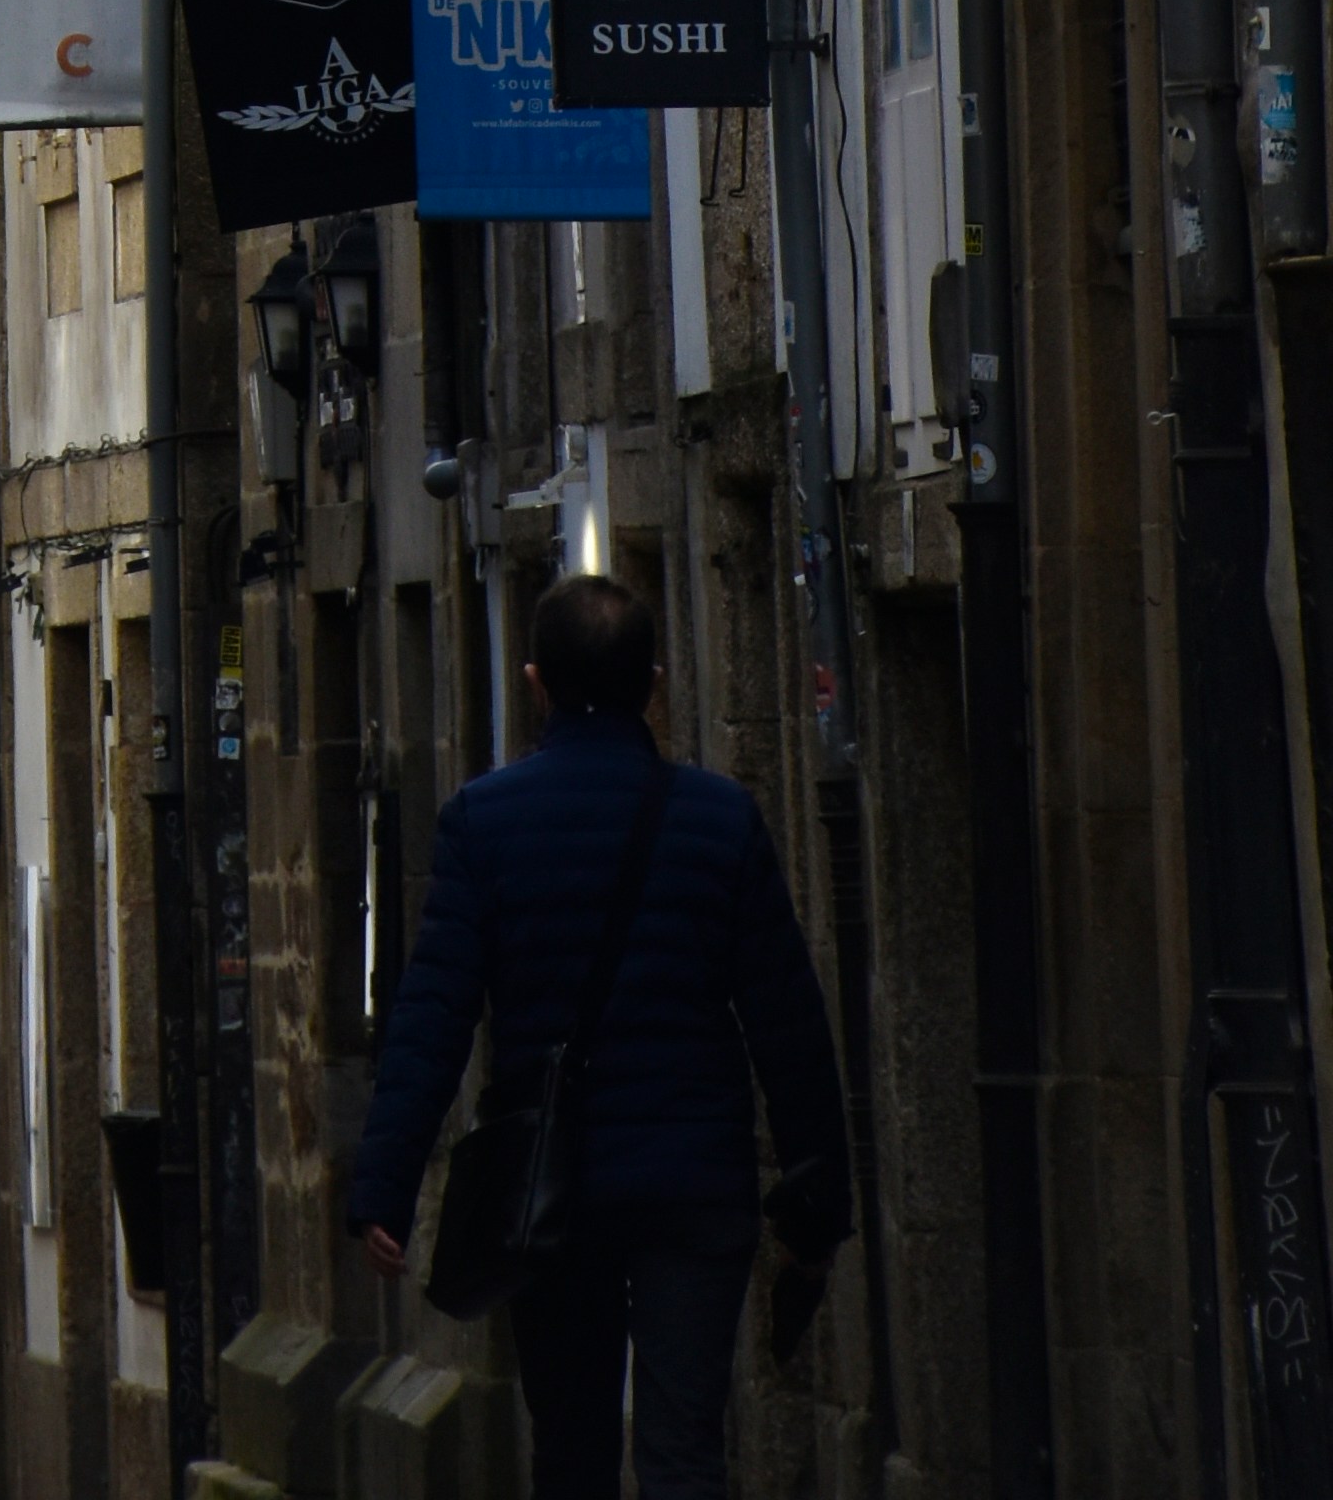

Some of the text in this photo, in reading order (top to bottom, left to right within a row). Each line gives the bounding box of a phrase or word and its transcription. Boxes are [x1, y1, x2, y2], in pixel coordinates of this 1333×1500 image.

[319, 36, 360, 80] A
[592, 22, 728, 54] SUSHI
[294, 73, 390, 114] LIGA
